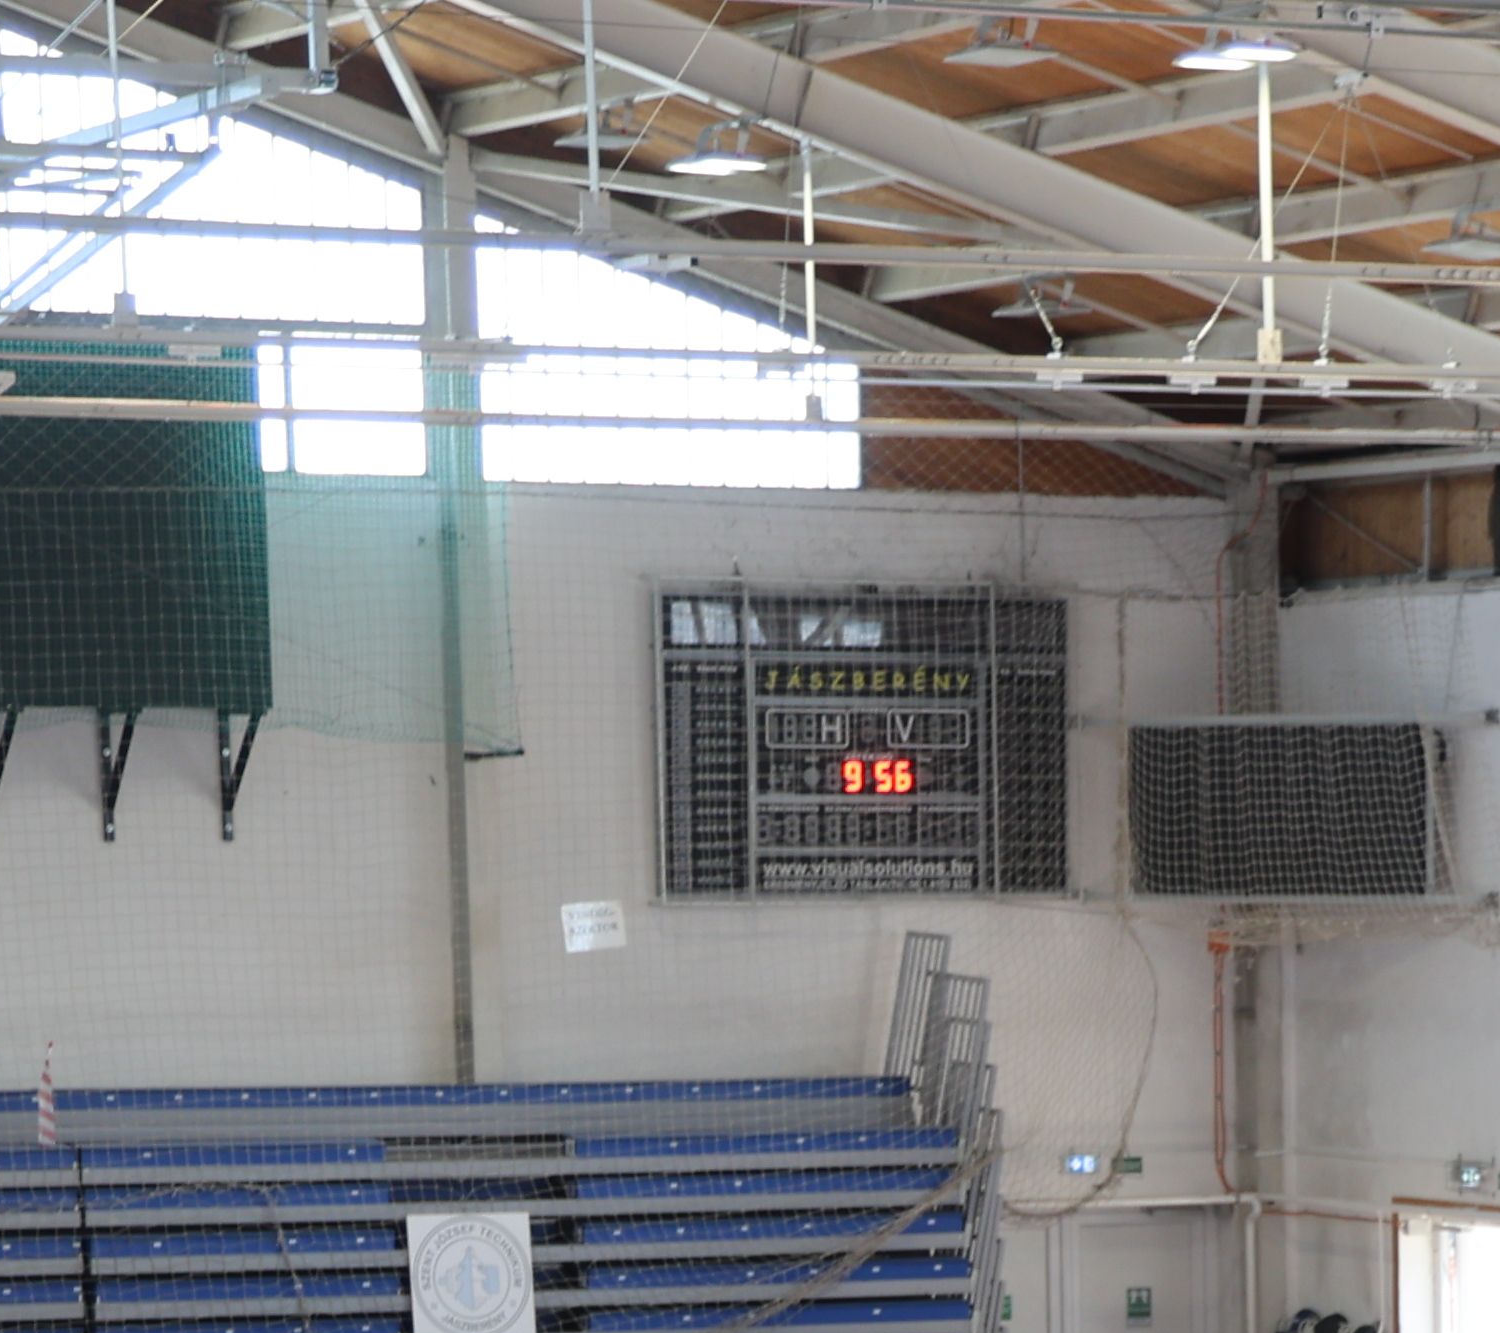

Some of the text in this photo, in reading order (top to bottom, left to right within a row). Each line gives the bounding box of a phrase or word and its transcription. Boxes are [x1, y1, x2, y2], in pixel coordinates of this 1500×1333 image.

[765, 666, 971, 691] JÁSZBERÉNY
[821, 714, 841, 742] H
[895, 714, 914, 742] V
[762, 859, 974, 877] www.visualsolutions.hu
